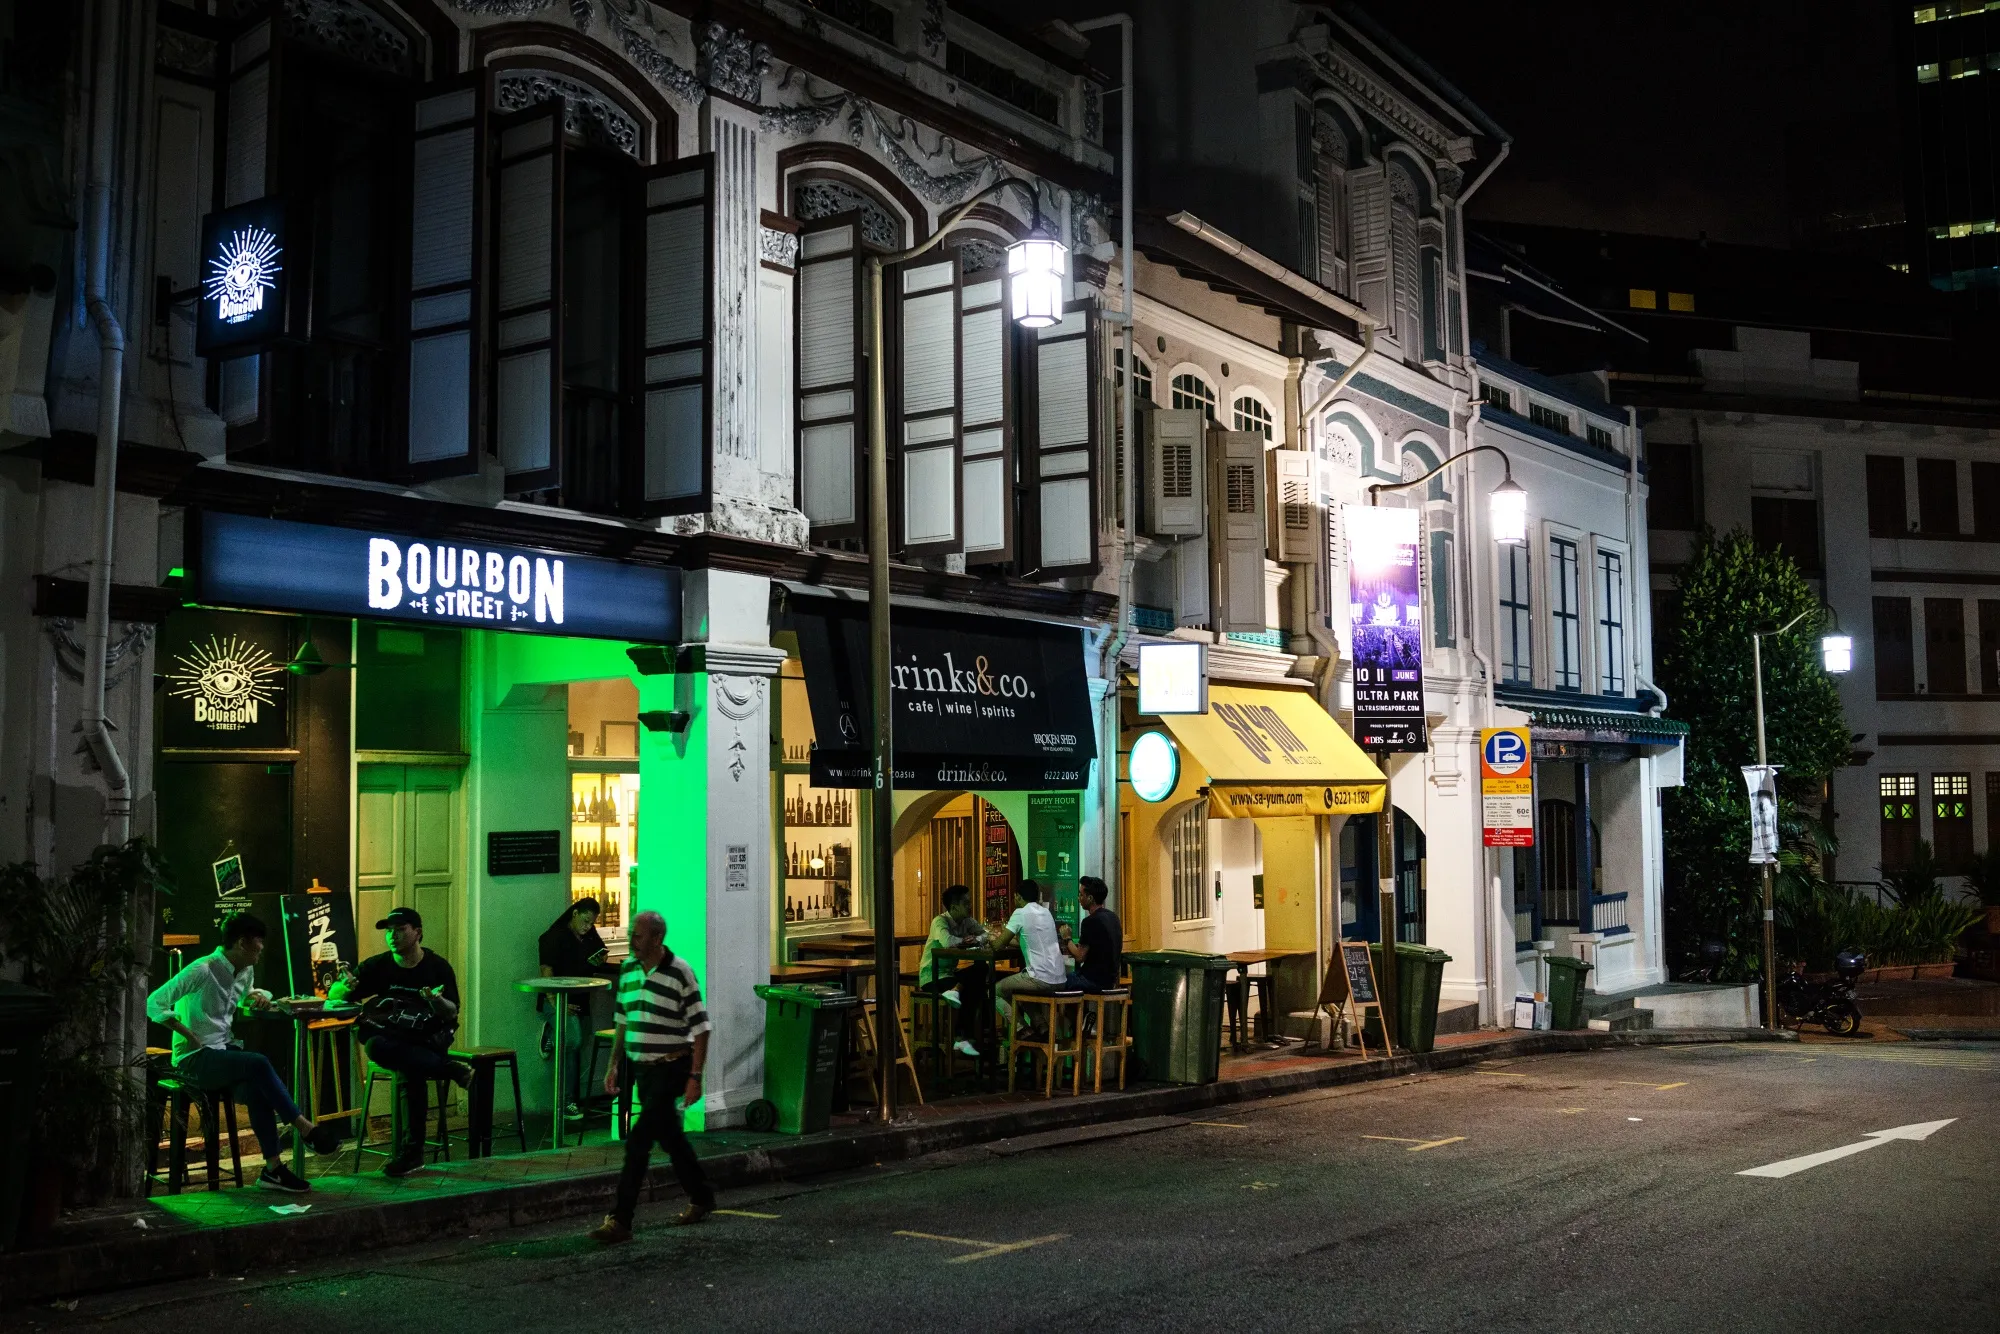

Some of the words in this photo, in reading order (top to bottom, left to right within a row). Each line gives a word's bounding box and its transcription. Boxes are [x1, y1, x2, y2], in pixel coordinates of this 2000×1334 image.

[219, 285, 263, 319] BOURBON
[368, 537, 564, 624] BOURBON
[435, 588, 504, 620] STREET
[891, 652, 1036, 699] rinks&co.
[1356, 668, 1369, 682] 10
[1395, 671, 1415, 680] JUNE
[1356, 690, 1390, 701] ULTRA
[1393, 690, 1419, 701] PARK
[194, 697, 258, 724] BOURBON
[908, 700, 934, 713] cafe
[945, 702, 972, 714] wine
[981, 705, 1016, 719] spirits
[1357, 704, 1420, 712] ULTRASINGAPORE.COM
[1033, 733, 1060, 746] BROKEN
[1060, 734, 1077, 745] SHED
[1370, 736, 1384, 744] DBS
[876, 755, 884, 789] 16
[937, 762, 1007, 782] drinks&co.
[1044, 771, 1060, 780] 6222
[1061, 771, 1079, 780] 2005
[1030, 797, 1053, 805] HAPPY
[1230, 792, 1303, 808] www.sa-yum.com
[1334, 792, 1353, 805] 6221
[1353, 791, 1370, 804] 1180
[985, 810, 1002, 823] FREE
